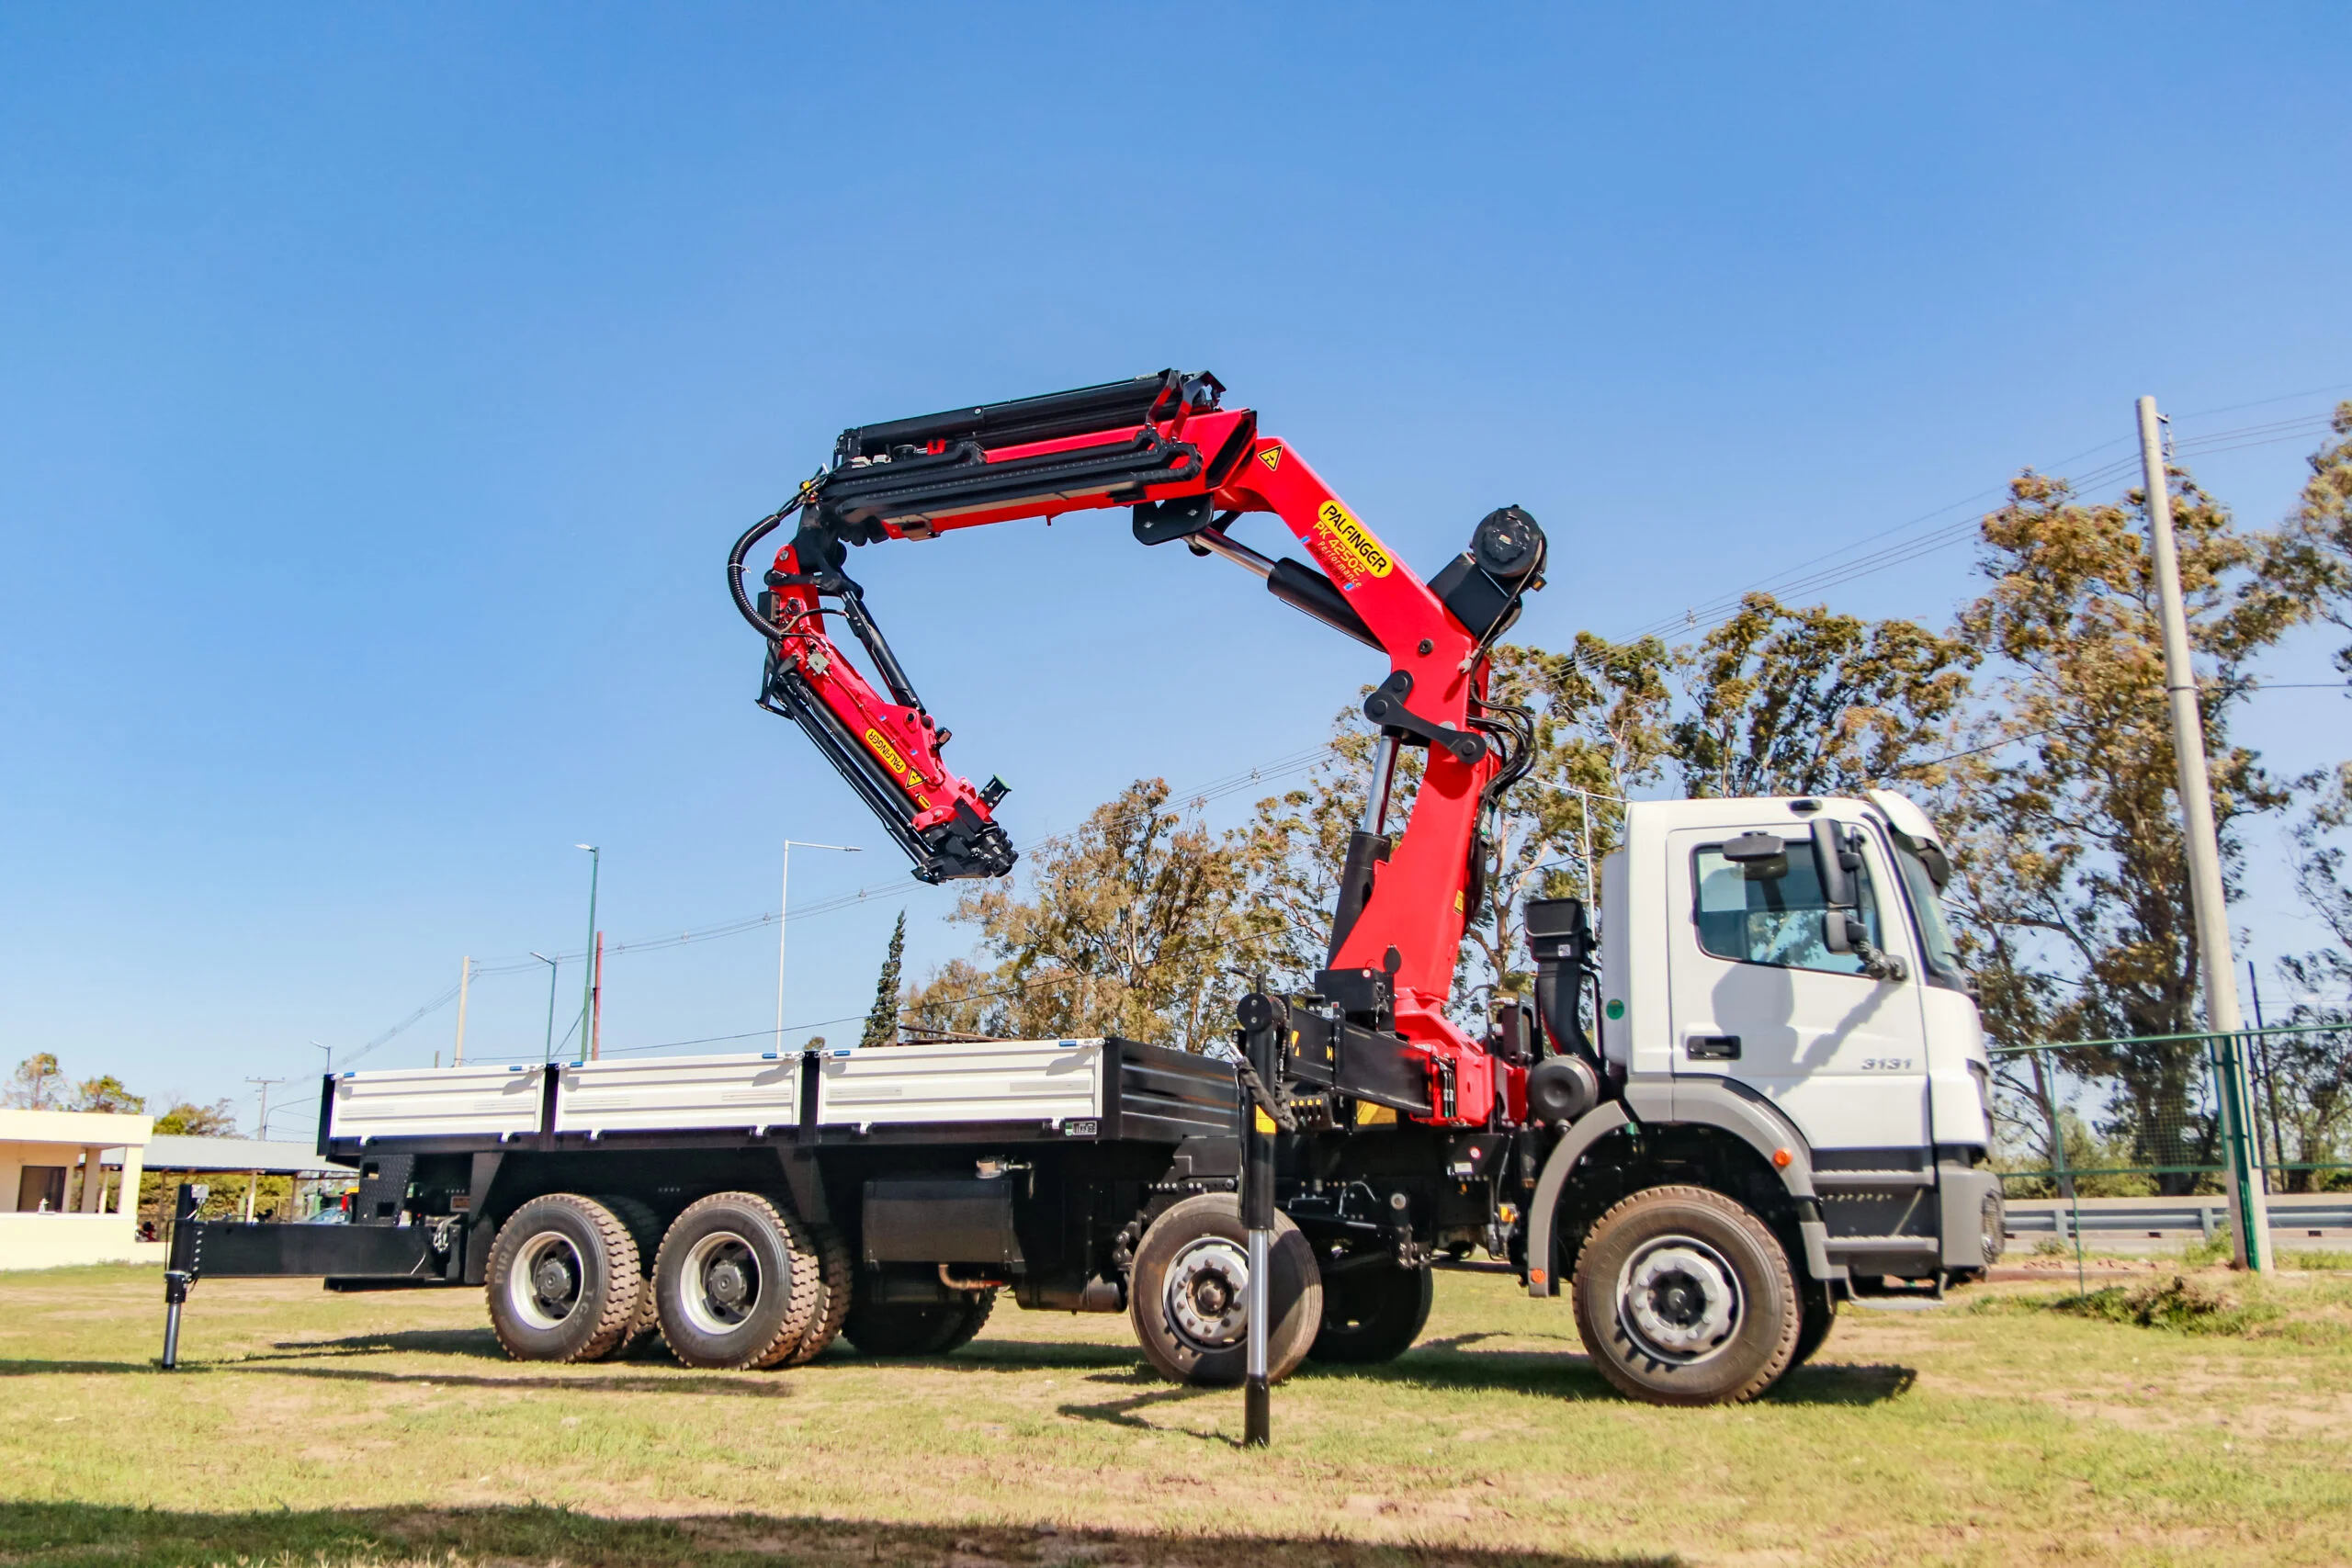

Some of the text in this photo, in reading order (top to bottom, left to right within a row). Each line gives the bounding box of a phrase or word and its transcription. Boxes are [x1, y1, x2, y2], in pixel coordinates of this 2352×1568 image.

[1312, 521, 1366, 576] PK 42502
[1323, 504, 1387, 572] PALFINGER
[1317, 540, 1363, 588] Performance
[868, 731, 904, 771] PALFINGER
[1860, 1057, 1912, 1070] 3131
